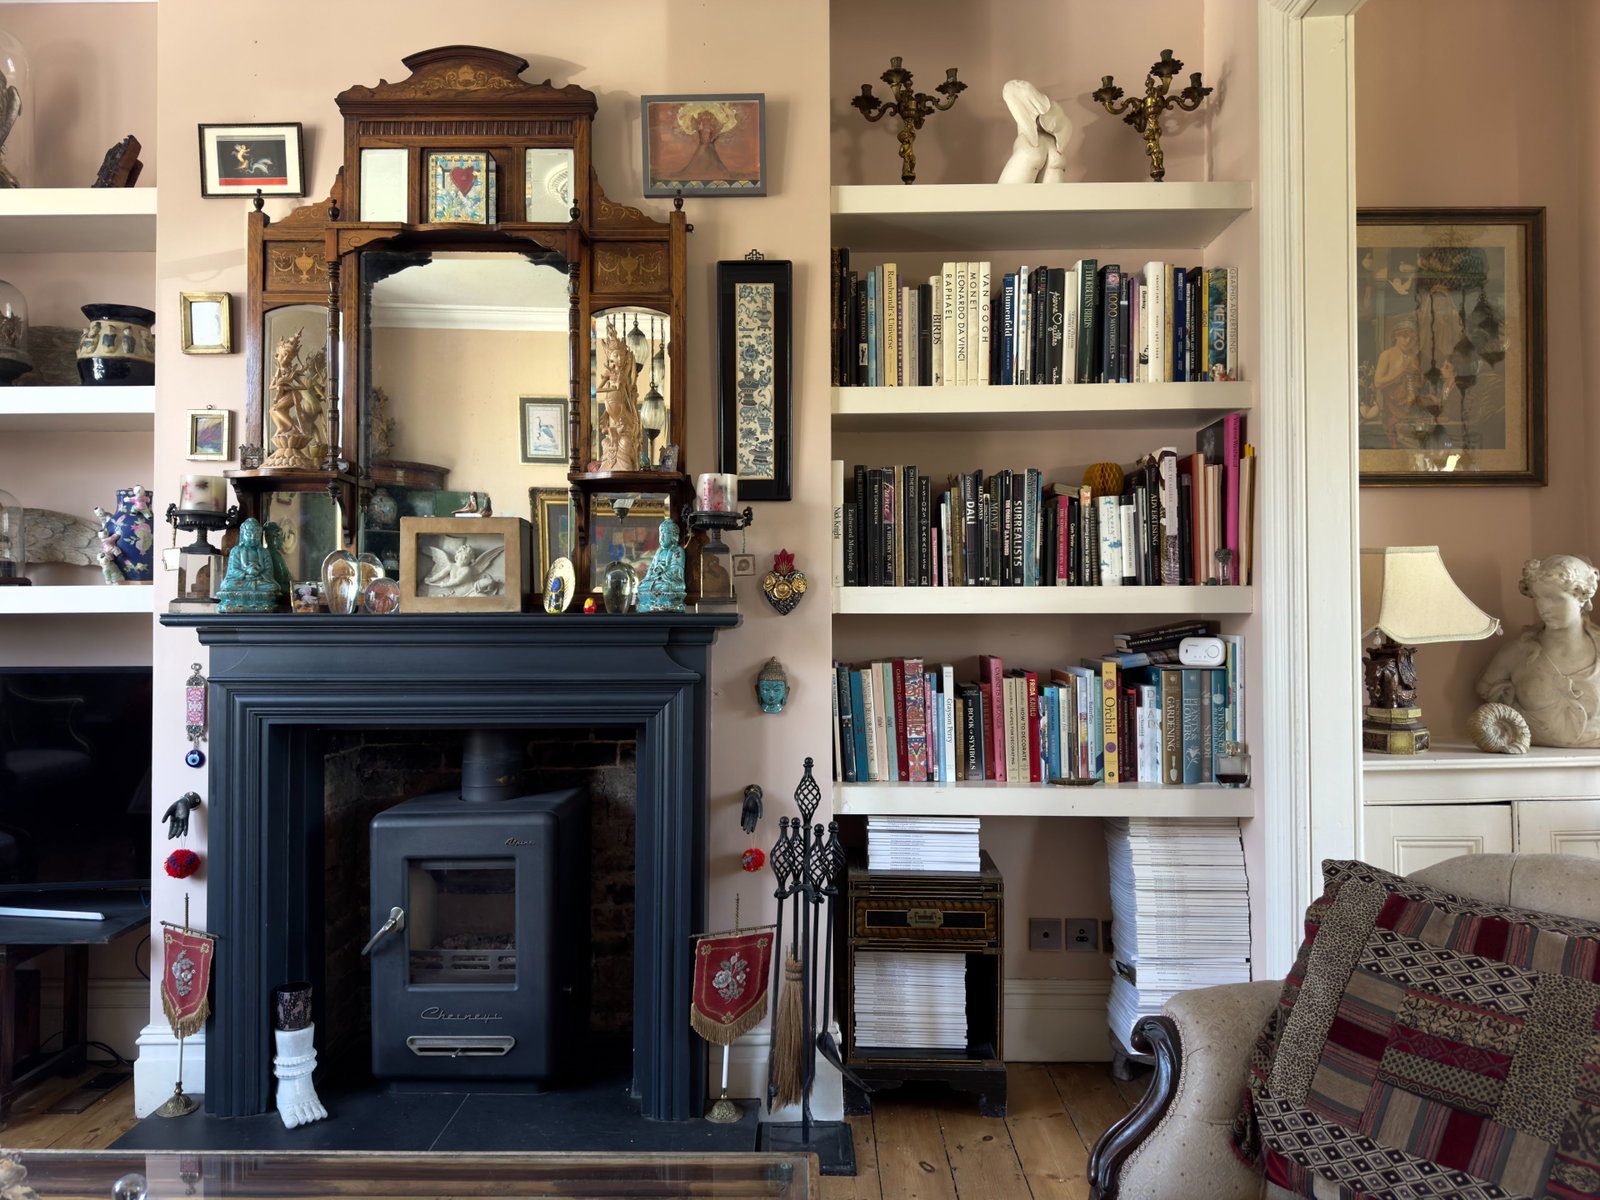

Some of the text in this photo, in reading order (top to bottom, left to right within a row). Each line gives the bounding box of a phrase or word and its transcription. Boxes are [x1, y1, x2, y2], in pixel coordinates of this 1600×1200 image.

[1004, 287, 1013, 337] Blumenfeld
[1048, 291, 1061, 347] pierre gilles
[1084, 308, 1093, 329] BIRDS
[1108, 293, 1118, 318] 1000
[933, 314, 942, 345] BIRDS
[958, 323, 965, 335] DA
[1213, 304, 1225, 350] KENZO
[883, 482, 894, 516] France
[833, 521, 841, 540] Knight
[990, 502, 999, 532] MONET
[1013, 500, 1022, 567] SURREALISTS
[1150, 493, 1159, 546] ADVERTISING
[864, 702, 874, 744] DECORATING
[945, 698, 953, 725] Grayson
[1021, 723, 1026, 731] TO
[1105, 697, 1116, 735] Orchid
[1167, 696, 1176, 752] GARDENING
[1184, 698, 1192, 741] FLOWERS
[1191, 697, 1199, 732] PLANTS
[968, 735, 976, 770] SYMBOLS
[420, 1006, 503, 1023] Chesneys
